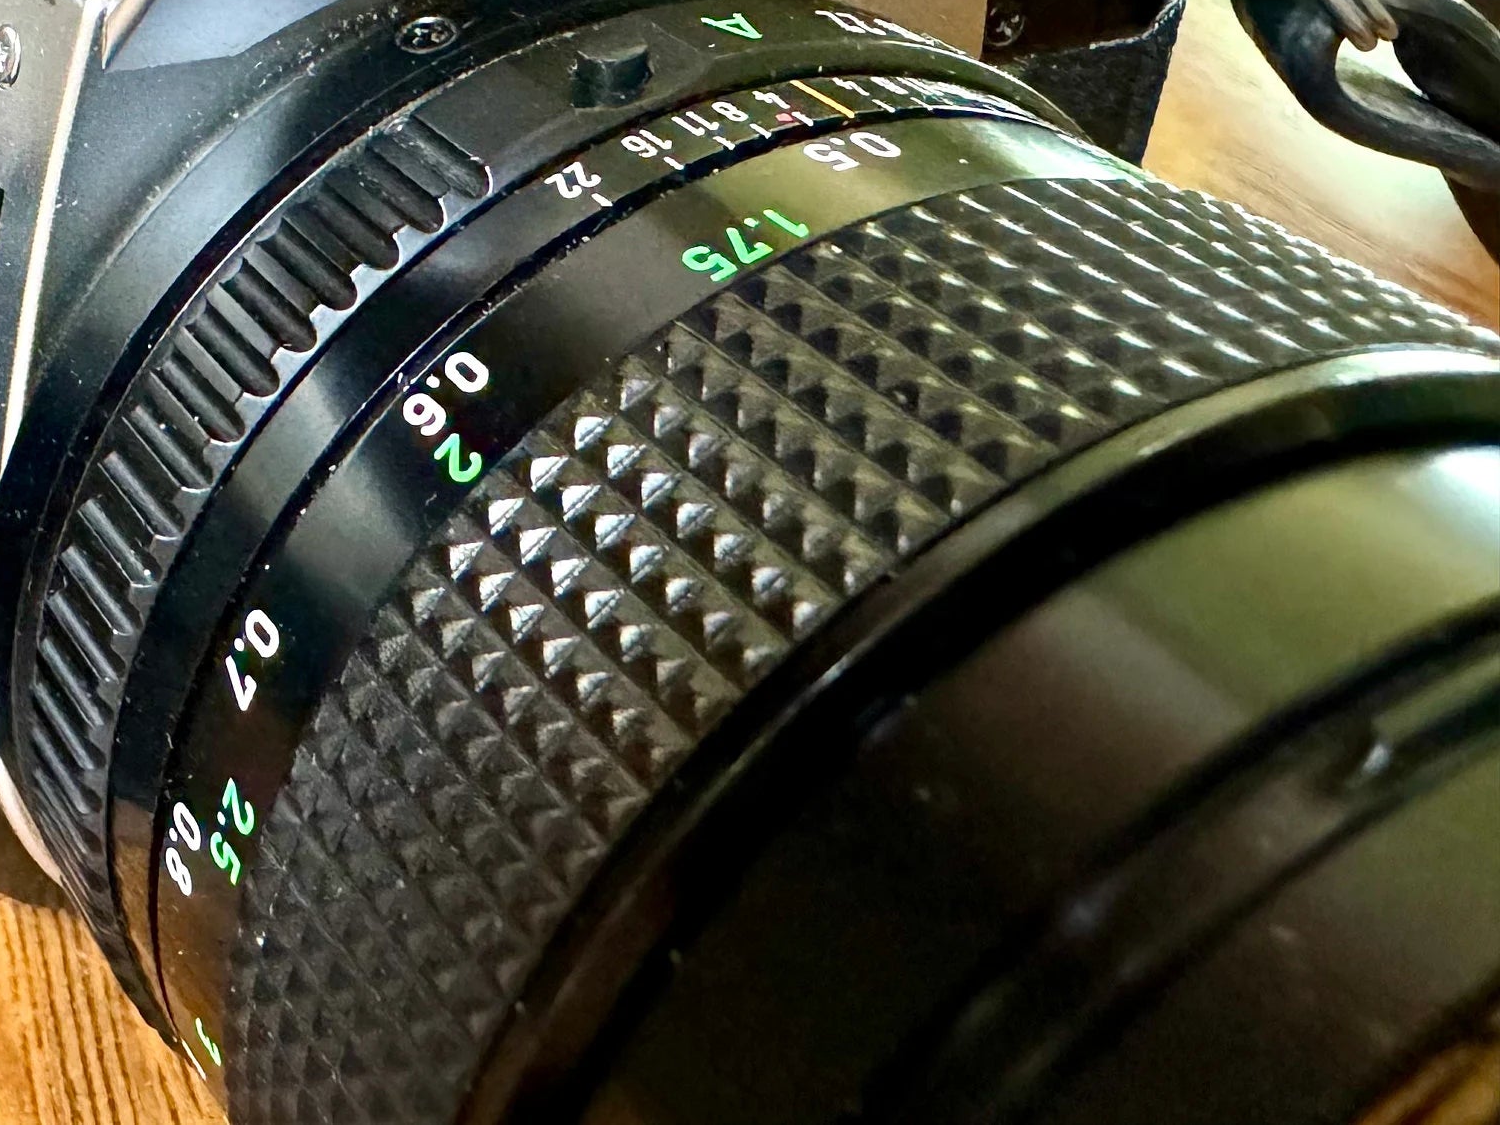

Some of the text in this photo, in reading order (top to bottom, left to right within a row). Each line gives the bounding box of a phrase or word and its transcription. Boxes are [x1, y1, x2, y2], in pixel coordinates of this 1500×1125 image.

[700, 12, 763, 40] A
[710, 101, 749, 129] 8
[752, 89, 792, 110] 4
[620, 127, 673, 159] 16
[671, 110, 721, 139] 11
[802, 131, 902, 172] 0.5
[544, 161, 602, 200] 22
[681, 208, 811, 283] 1.75
[401, 351, 489, 437] 0.6
[434, 432, 483, 483] 2
[226, 609, 280, 712] 0.7
[165, 802, 201, 897] 0.8
[209, 778, 255, 886] 2.5
